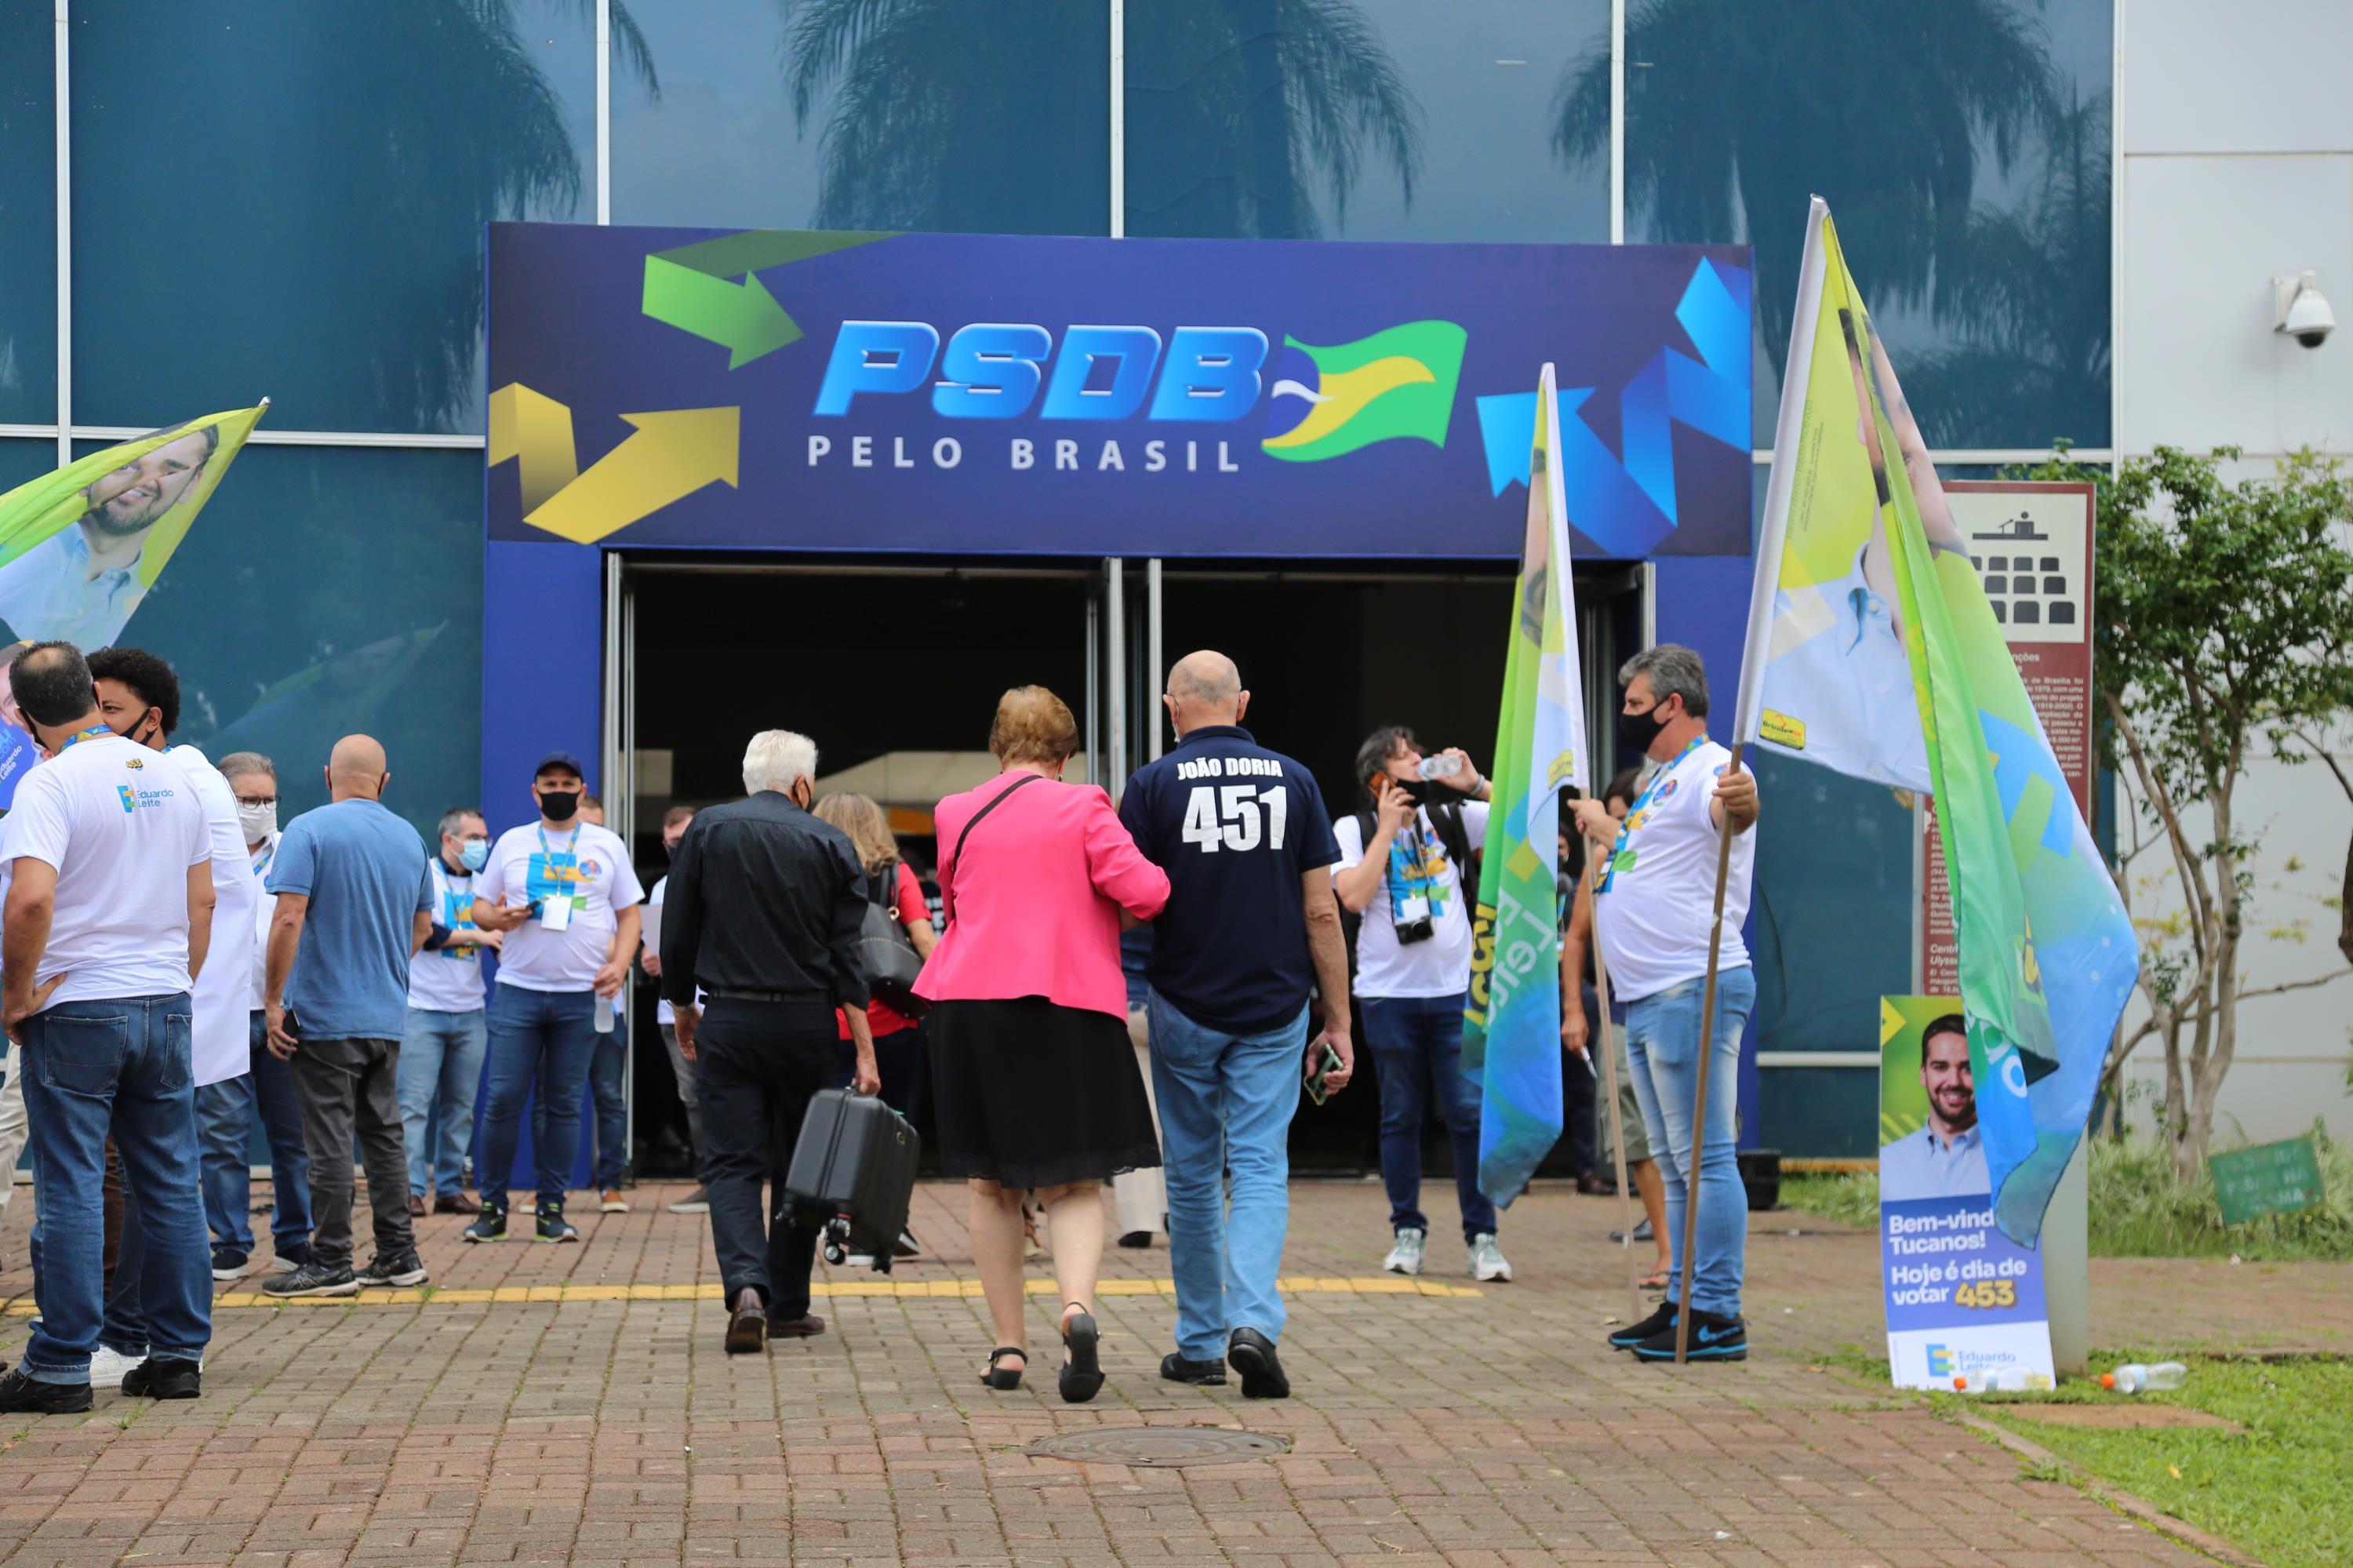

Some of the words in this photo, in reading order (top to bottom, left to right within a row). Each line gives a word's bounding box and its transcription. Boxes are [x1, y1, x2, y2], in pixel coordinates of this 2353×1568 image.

[812, 319, 1270, 420] PSDB
[808, 435, 962, 468] PELO
[1011, 438, 1238, 471] BRASIL
[2012, 652, 2040, 663] nções
[0, 745, 22, 773] duardo
[1177, 757, 1222, 780] JOÃO
[1225, 758, 1283, 777] DORIA
[136, 789, 174, 799] Eduardo
[138, 799, 161, 808] Leite
[1182, 784, 1287, 853] 451
[1889, 1208, 1995, 1235] Bem-vind
[1889, 1230, 1986, 1255] Tucanos!
[1891, 1264, 1943, 1286] Hoje
[1944, 1259, 1959, 1281] é
[1962, 1259, 1996, 1279] dia
[1998, 1257, 2028, 1277] de
[1892, 1285, 1950, 1306] votar
[1955, 1279, 2016, 1308] 453
[1959, 1351, 2017, 1363] Eduardo
